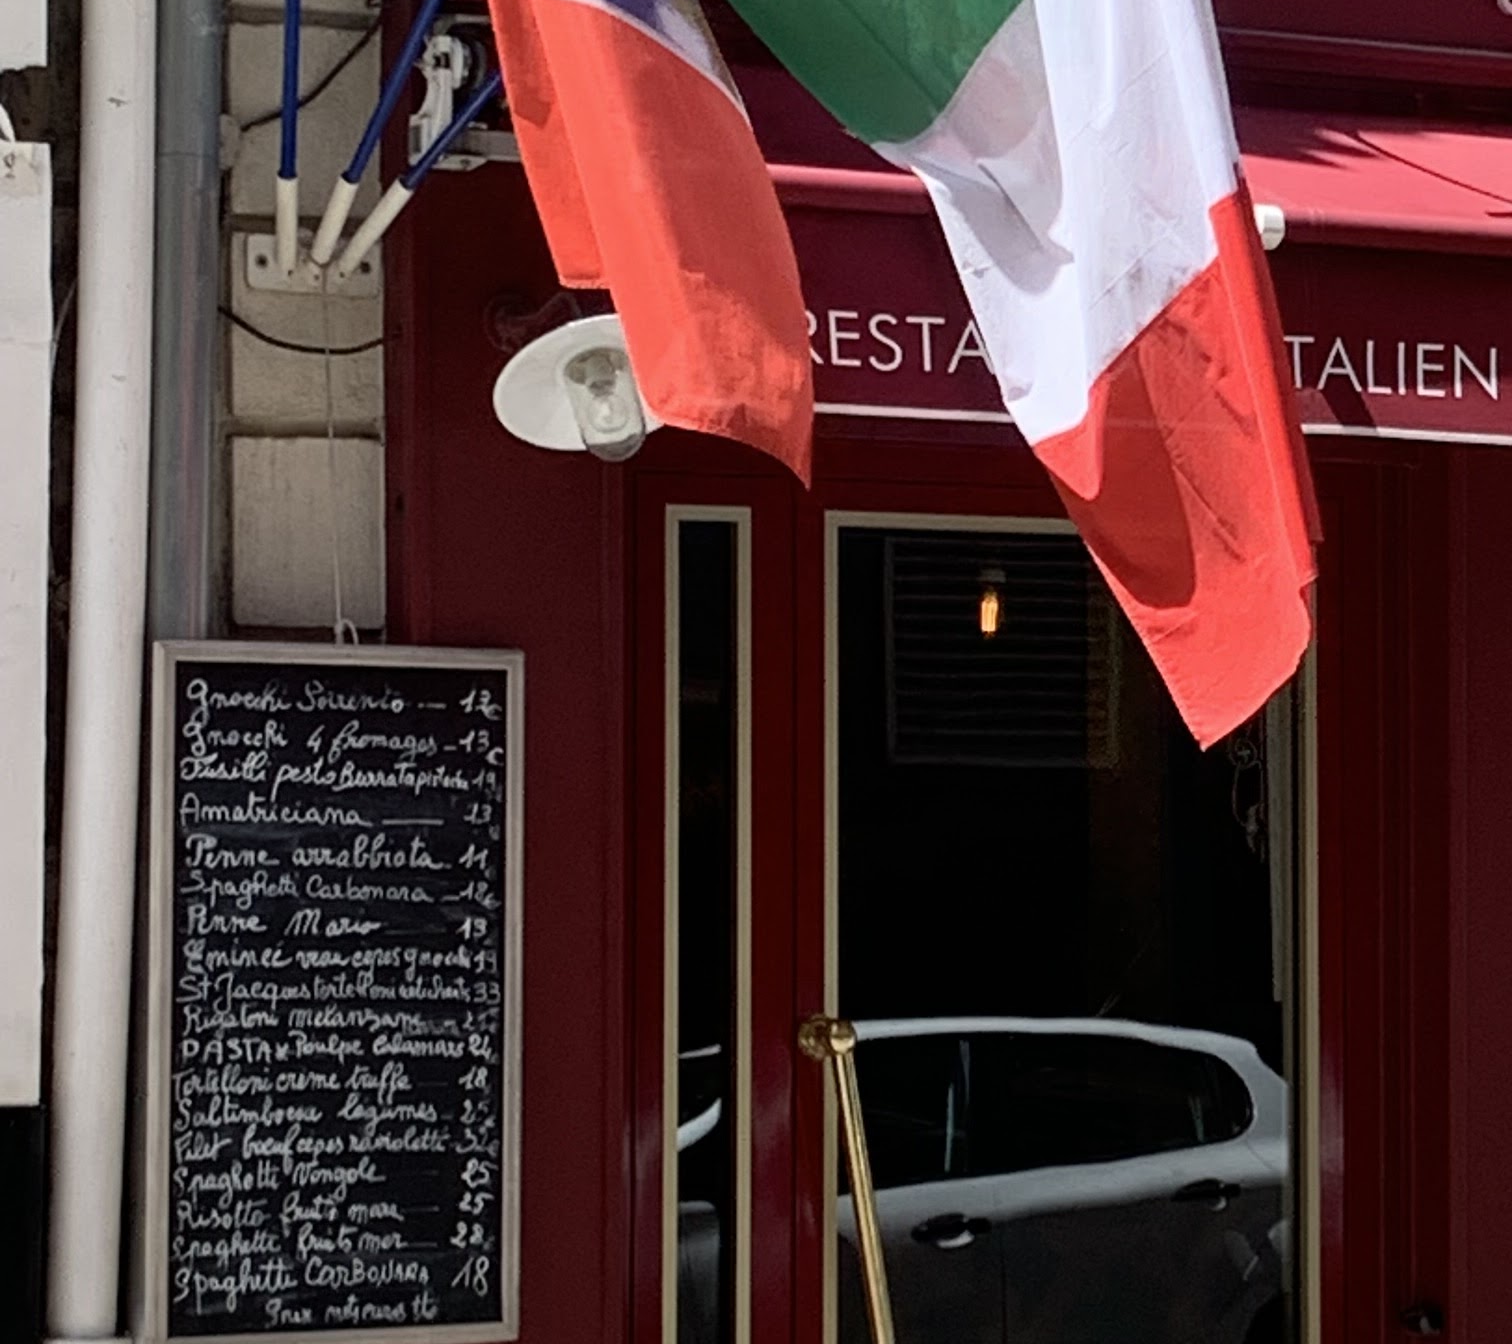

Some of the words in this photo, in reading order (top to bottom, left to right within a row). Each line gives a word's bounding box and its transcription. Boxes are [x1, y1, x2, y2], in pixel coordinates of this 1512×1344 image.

[1282, 334, 1500, 401] TALIEN
[306, 725, 326, 754] 4
[185, 833, 280, 869] Penne
